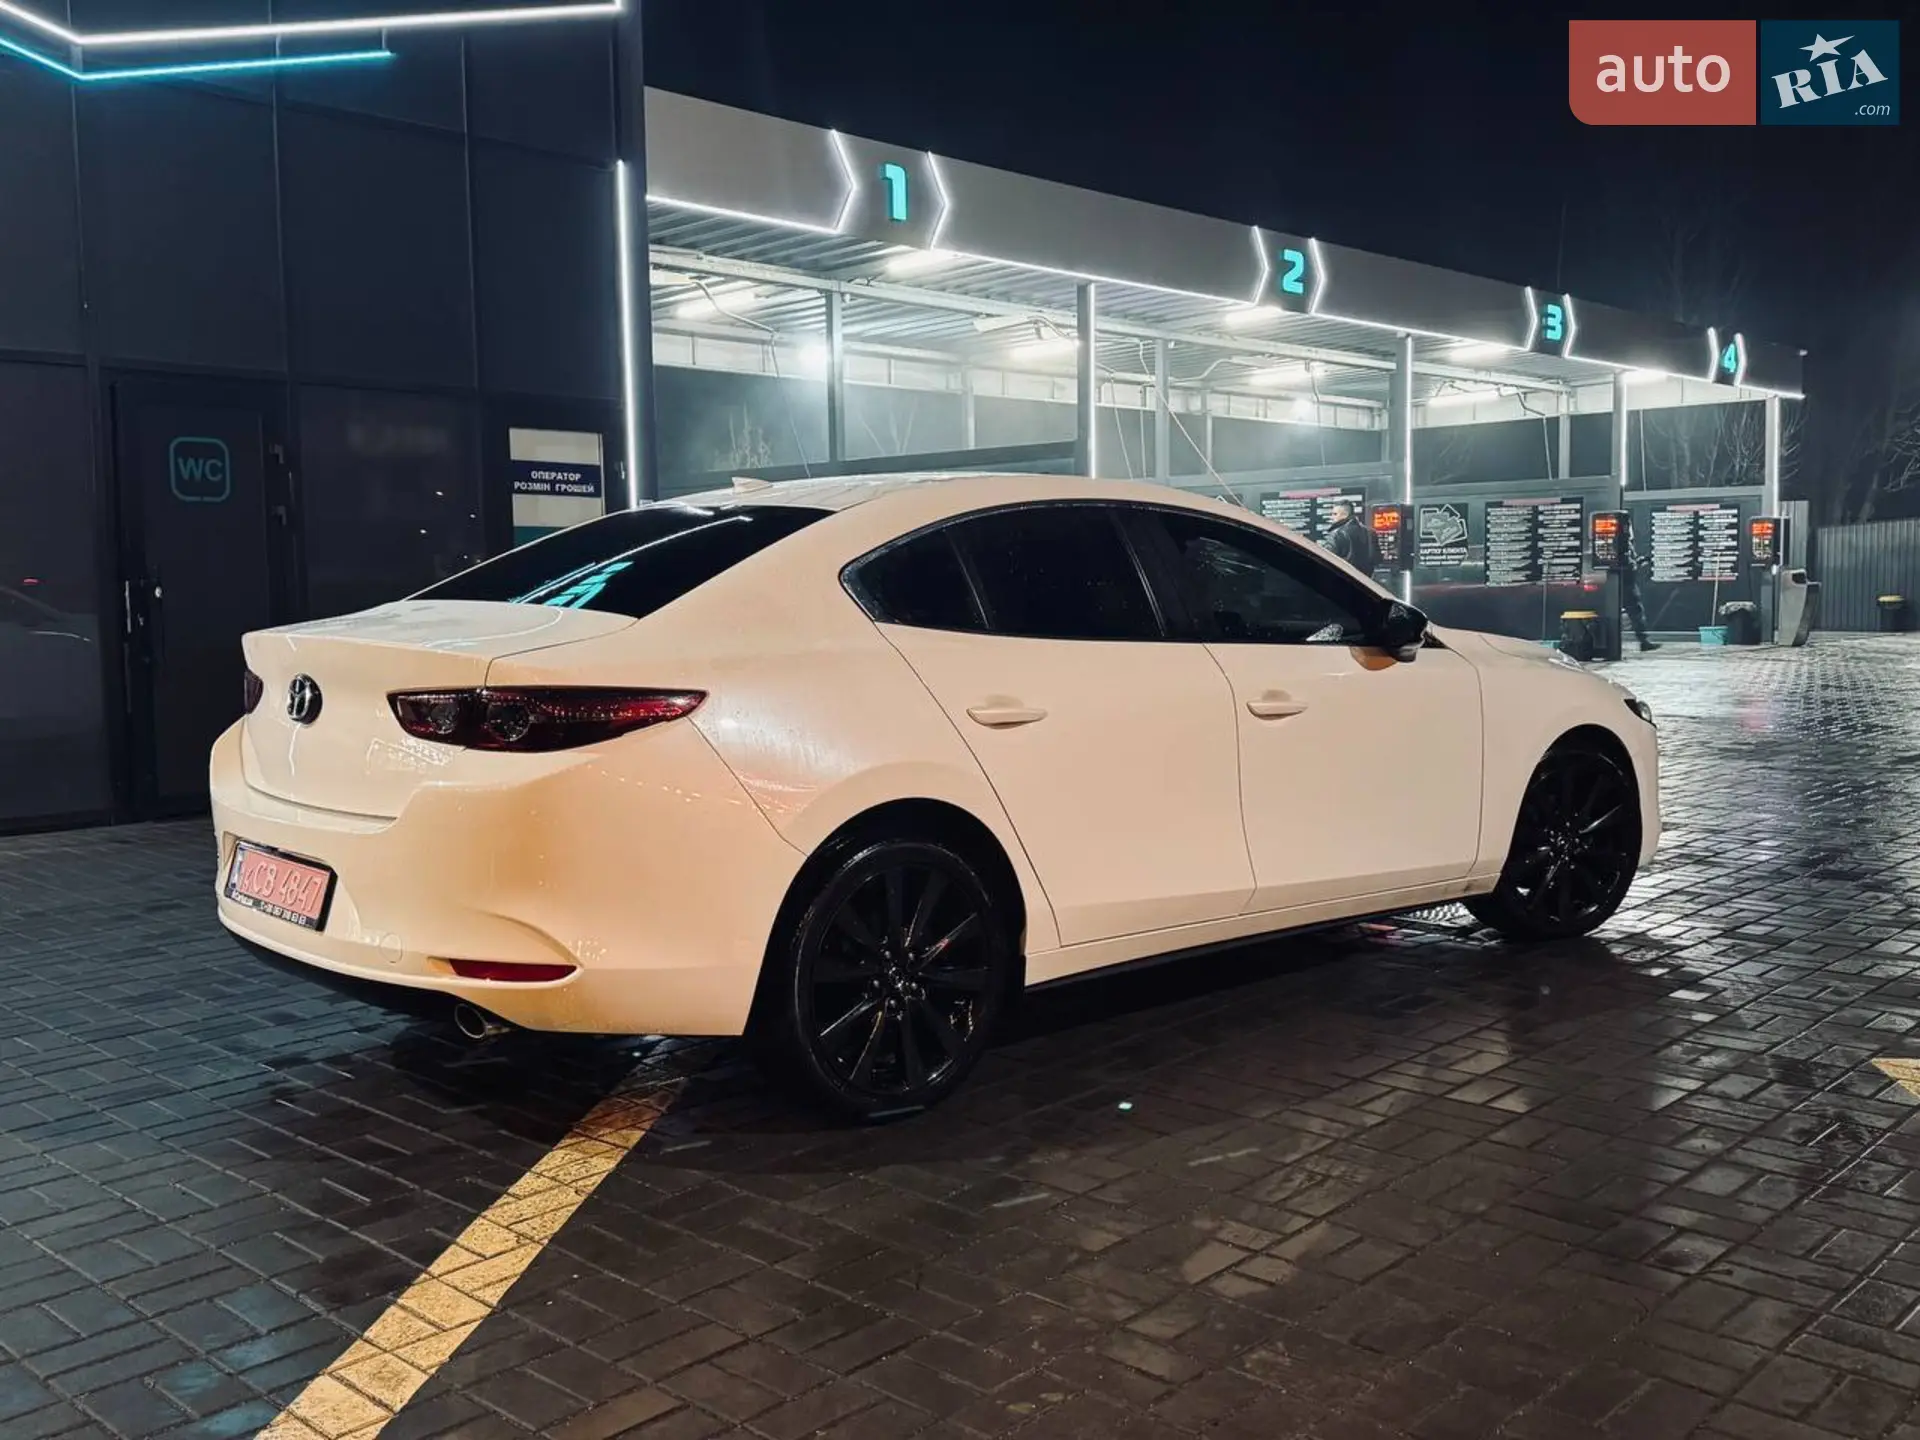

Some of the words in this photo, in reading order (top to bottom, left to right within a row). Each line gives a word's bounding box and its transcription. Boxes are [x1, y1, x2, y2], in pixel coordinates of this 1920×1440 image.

[883, 162, 907, 221] 1
[1282, 248, 1305, 295] 2
[1546, 303, 1563, 341] 3
[1723, 342, 1737, 373] 4
[177, 456, 224, 482] WC
[530, 470, 582, 482] ОПЕРАТОР
[513, 480, 551, 492] РОЗМІН
[555, 482, 595, 494] ГРОШЕЙ
